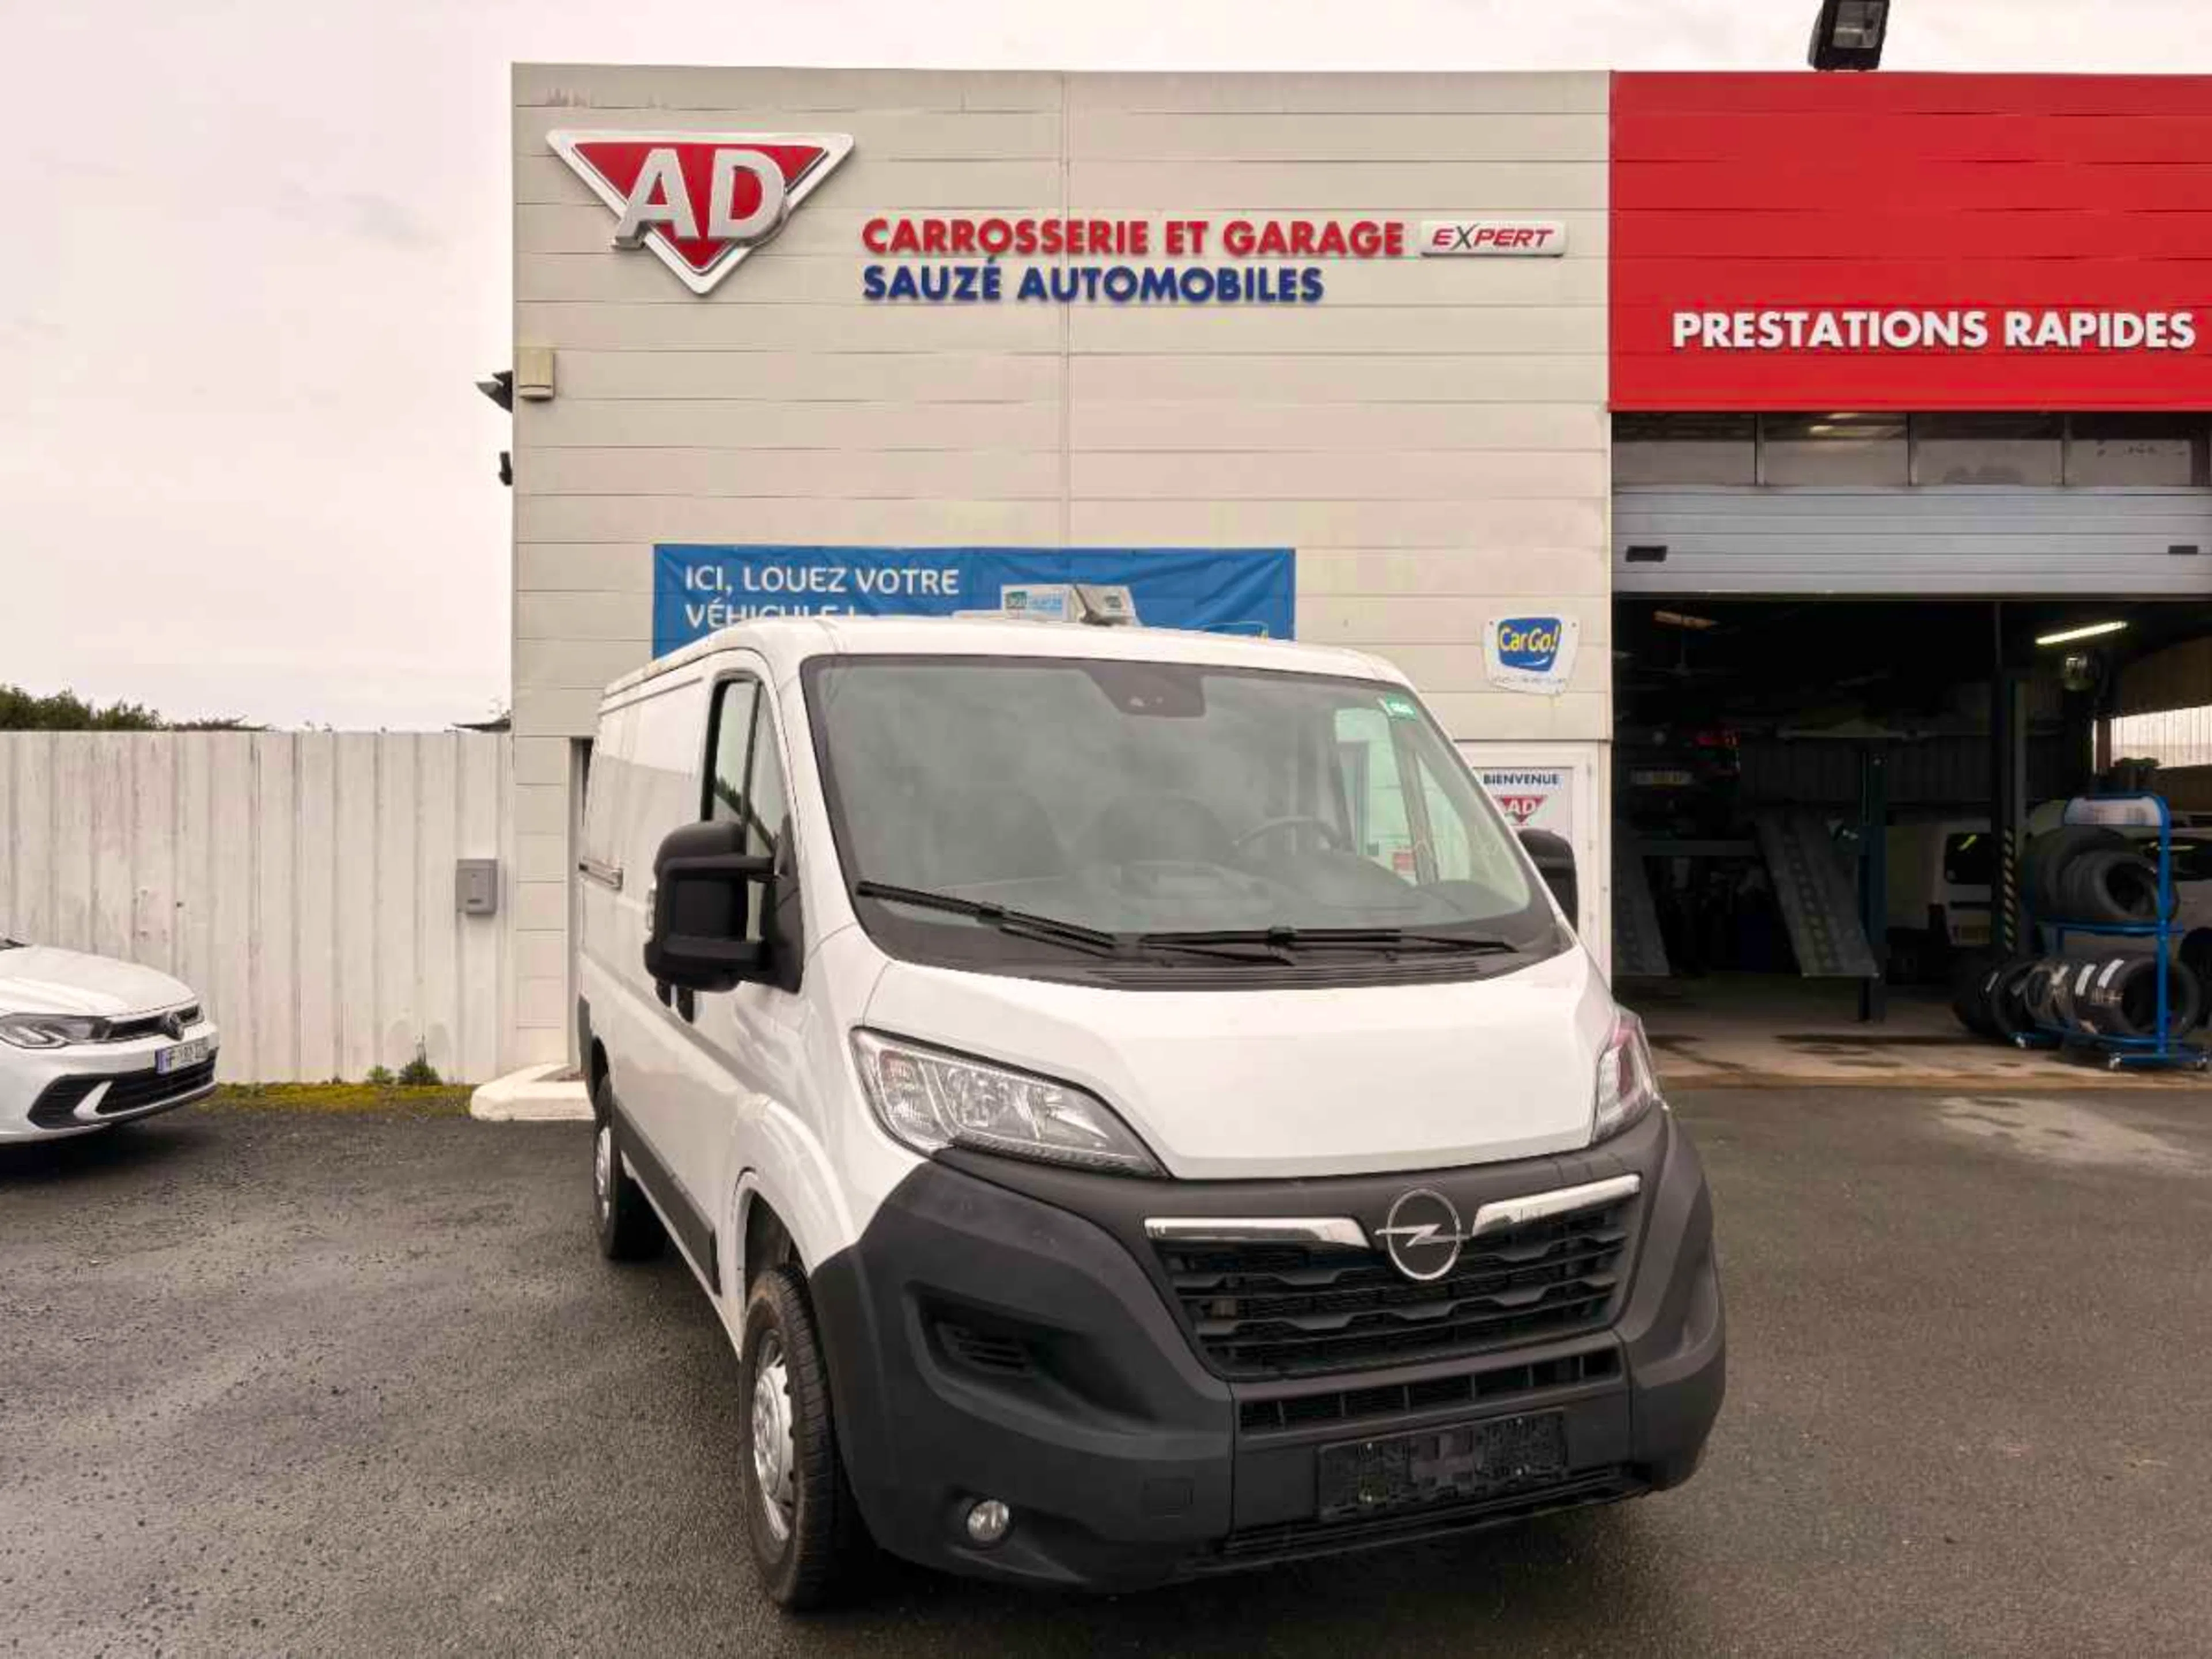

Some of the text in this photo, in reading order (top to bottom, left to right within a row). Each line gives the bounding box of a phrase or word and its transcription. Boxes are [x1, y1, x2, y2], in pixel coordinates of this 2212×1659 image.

[615, 147, 786, 241] AD
[862, 218, 1404, 257] CARROSSERIE ET GARAGE
[1432, 222, 1554, 249] EXPERT
[863, 256, 1324, 303] SAUZÉ AUTOMOBILES
[1673, 311, 2196, 349] PRESTATIONS RAPIDES
[685, 566, 960, 596] ICI, LOUEZ VOTRE
[1483, 774, 1559, 785] BIENVENUE
